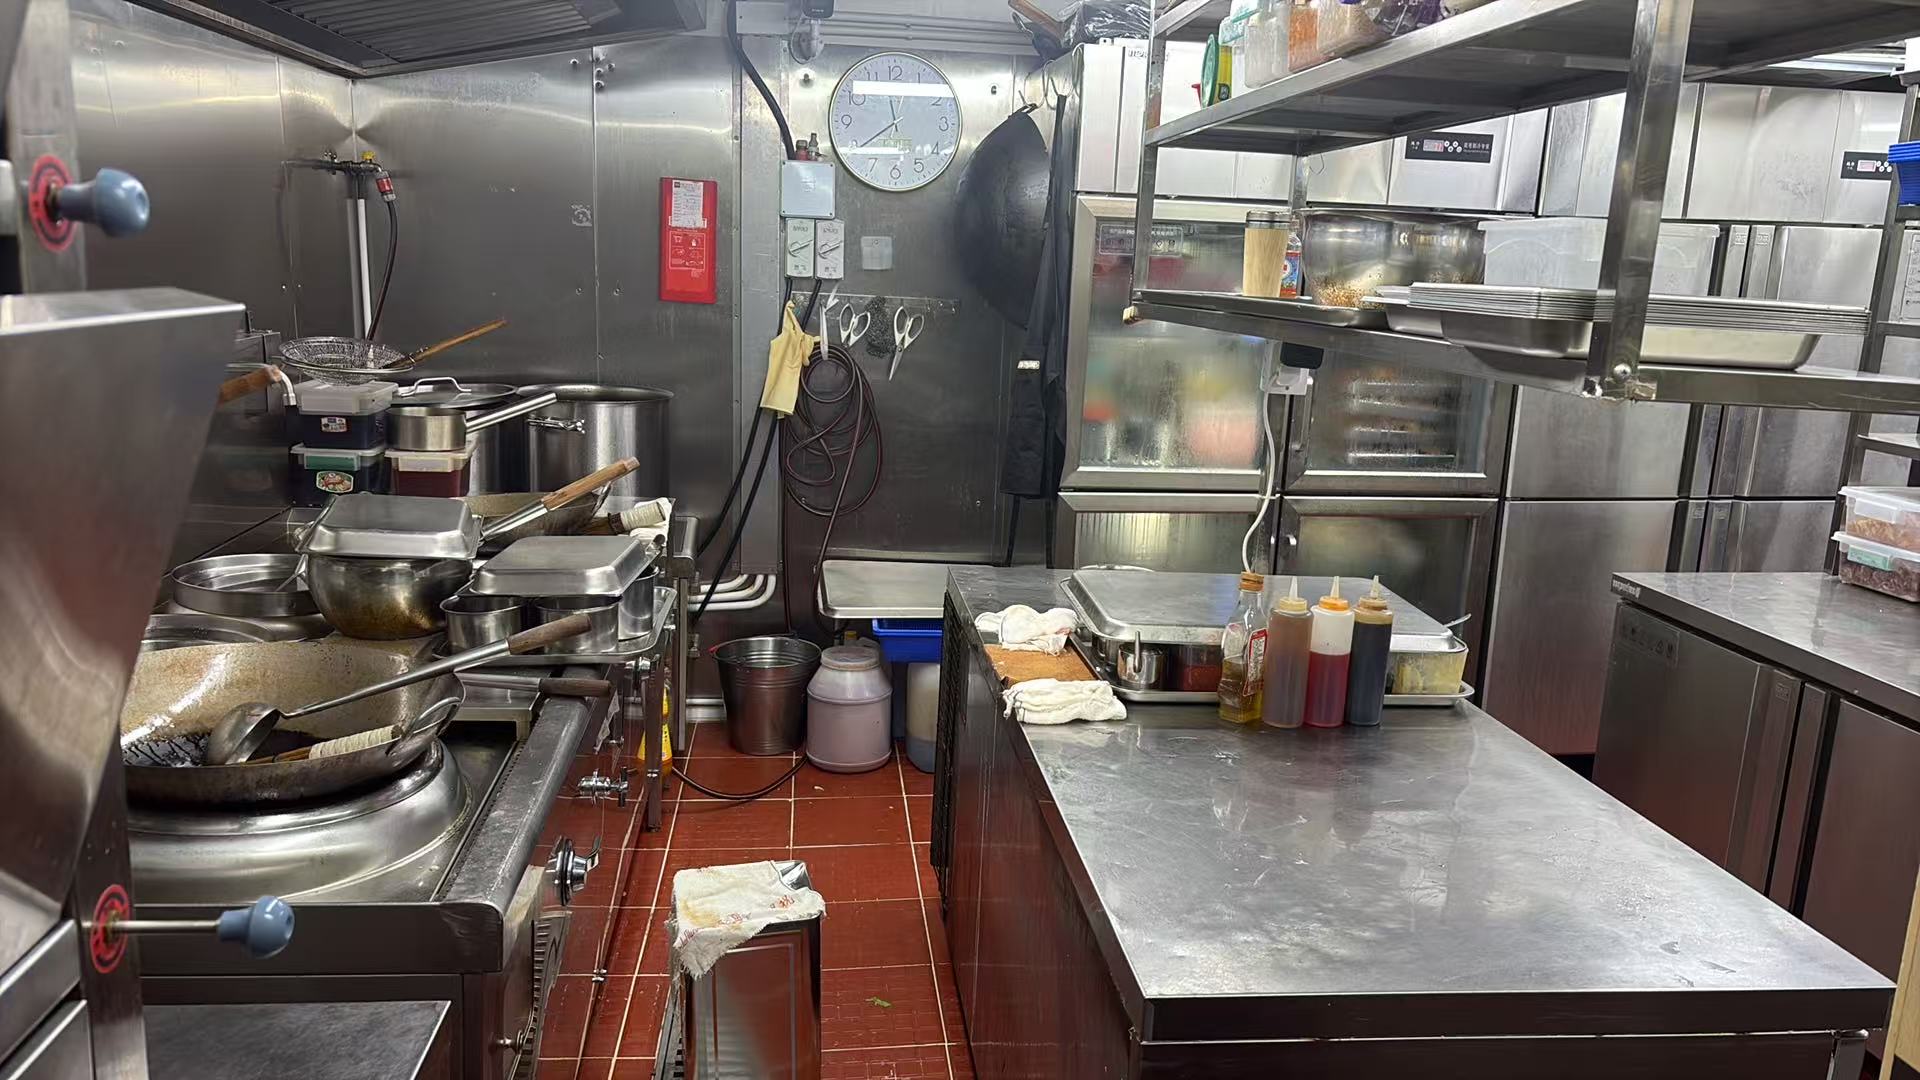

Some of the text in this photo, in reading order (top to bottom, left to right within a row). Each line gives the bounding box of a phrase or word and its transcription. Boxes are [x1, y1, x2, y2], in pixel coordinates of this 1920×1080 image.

[867, 71, 878, 81] 11
[888, 66, 902, 81] 12
[849, 91, 866, 106] 10
[841, 114, 852, 128] 9
[939, 116, 949, 132] 3
[931, 141, 939, 155] 4
[868, 158, 878, 172] 7
[890, 164, 901, 179] 6
[914, 158, 924, 173] 5
